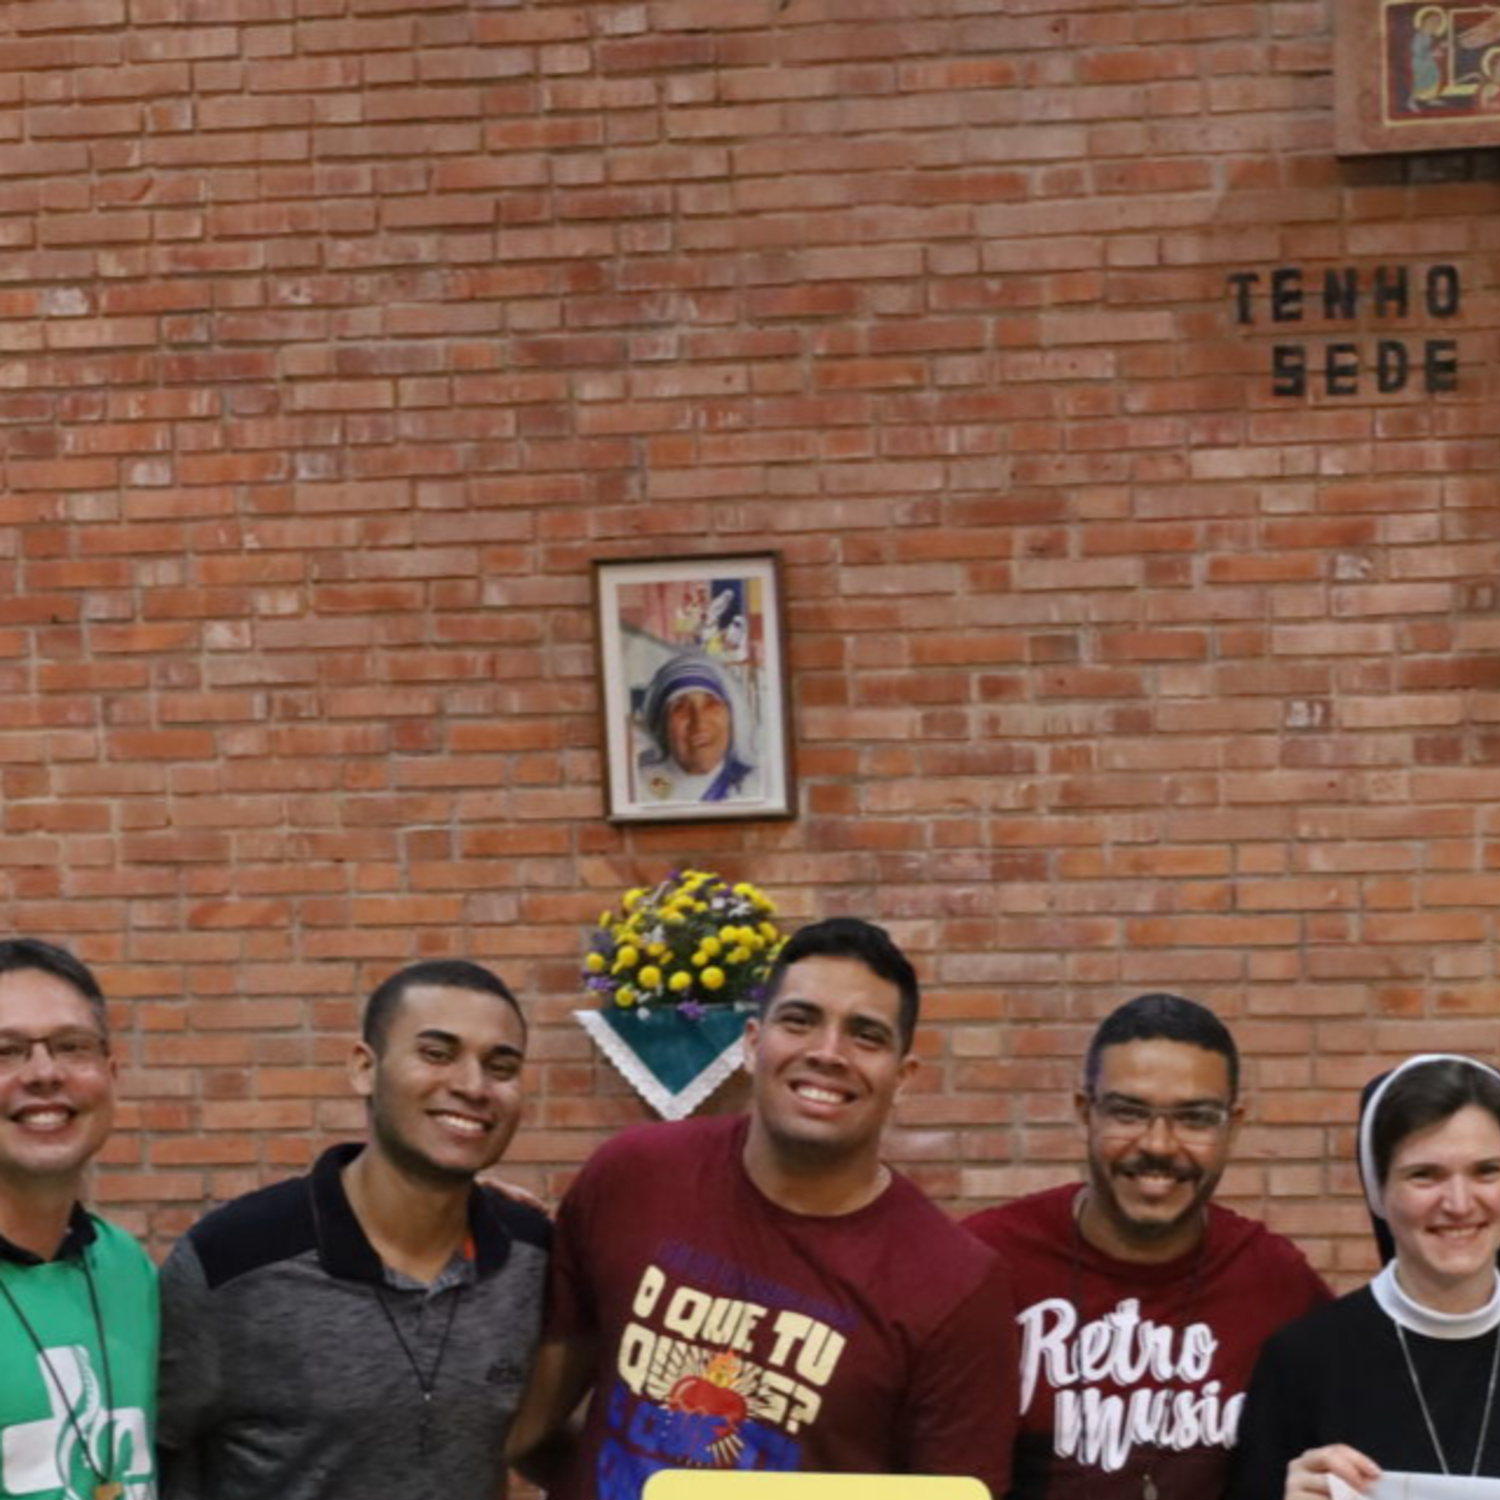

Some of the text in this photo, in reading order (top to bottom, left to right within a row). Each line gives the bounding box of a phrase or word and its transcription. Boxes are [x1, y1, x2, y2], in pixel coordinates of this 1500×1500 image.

[1227, 264, 1460, 324] TENHO
[1272, 340, 1458, 396] SEDE
[633, 1264, 667, 1318] O
[664, 1286, 769, 1353] QUE
[768, 1310, 848, 1386] TU
[1015, 1297, 1219, 1416] Retro
